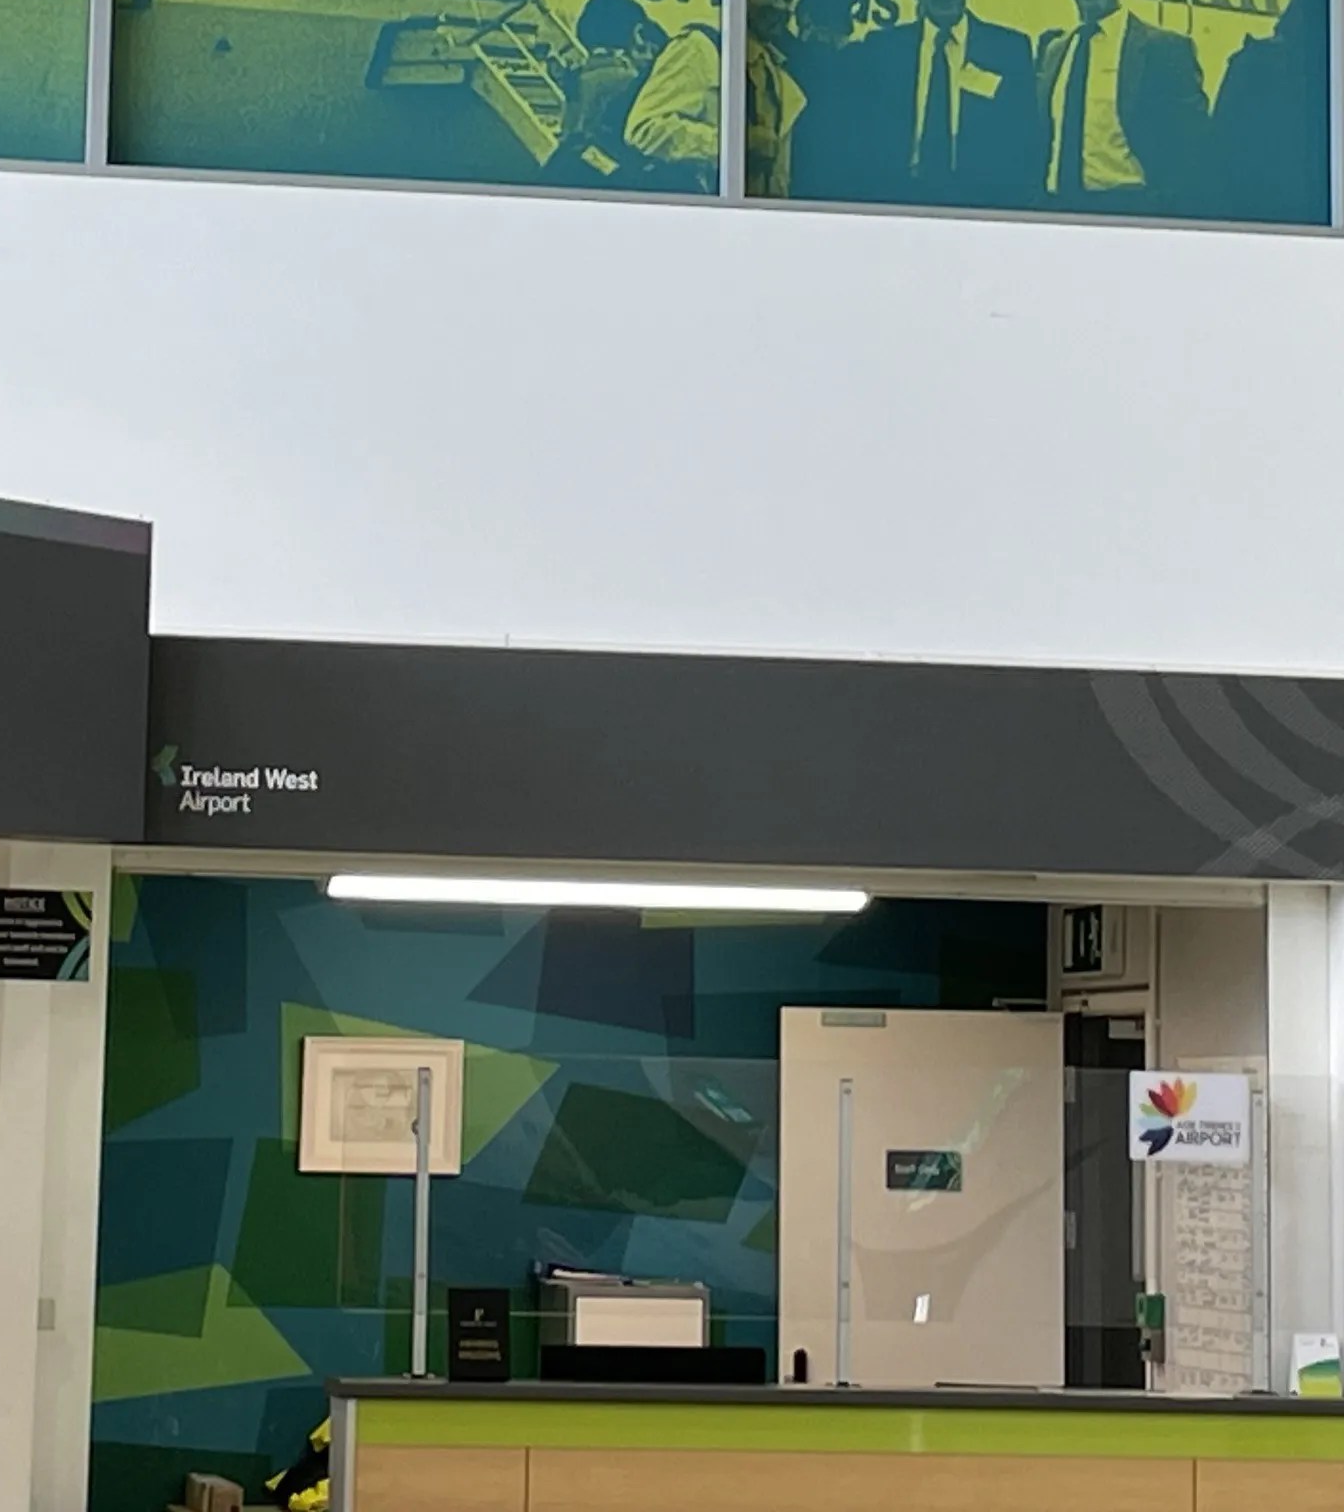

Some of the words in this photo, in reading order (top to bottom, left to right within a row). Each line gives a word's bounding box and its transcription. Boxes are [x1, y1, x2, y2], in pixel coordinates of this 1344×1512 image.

[180, 764, 259, 790] Ireland
[264, 767, 319, 792] West
[178, 790, 252, 817] Airport
[1174, 1129, 1241, 1148] AIRPORT
